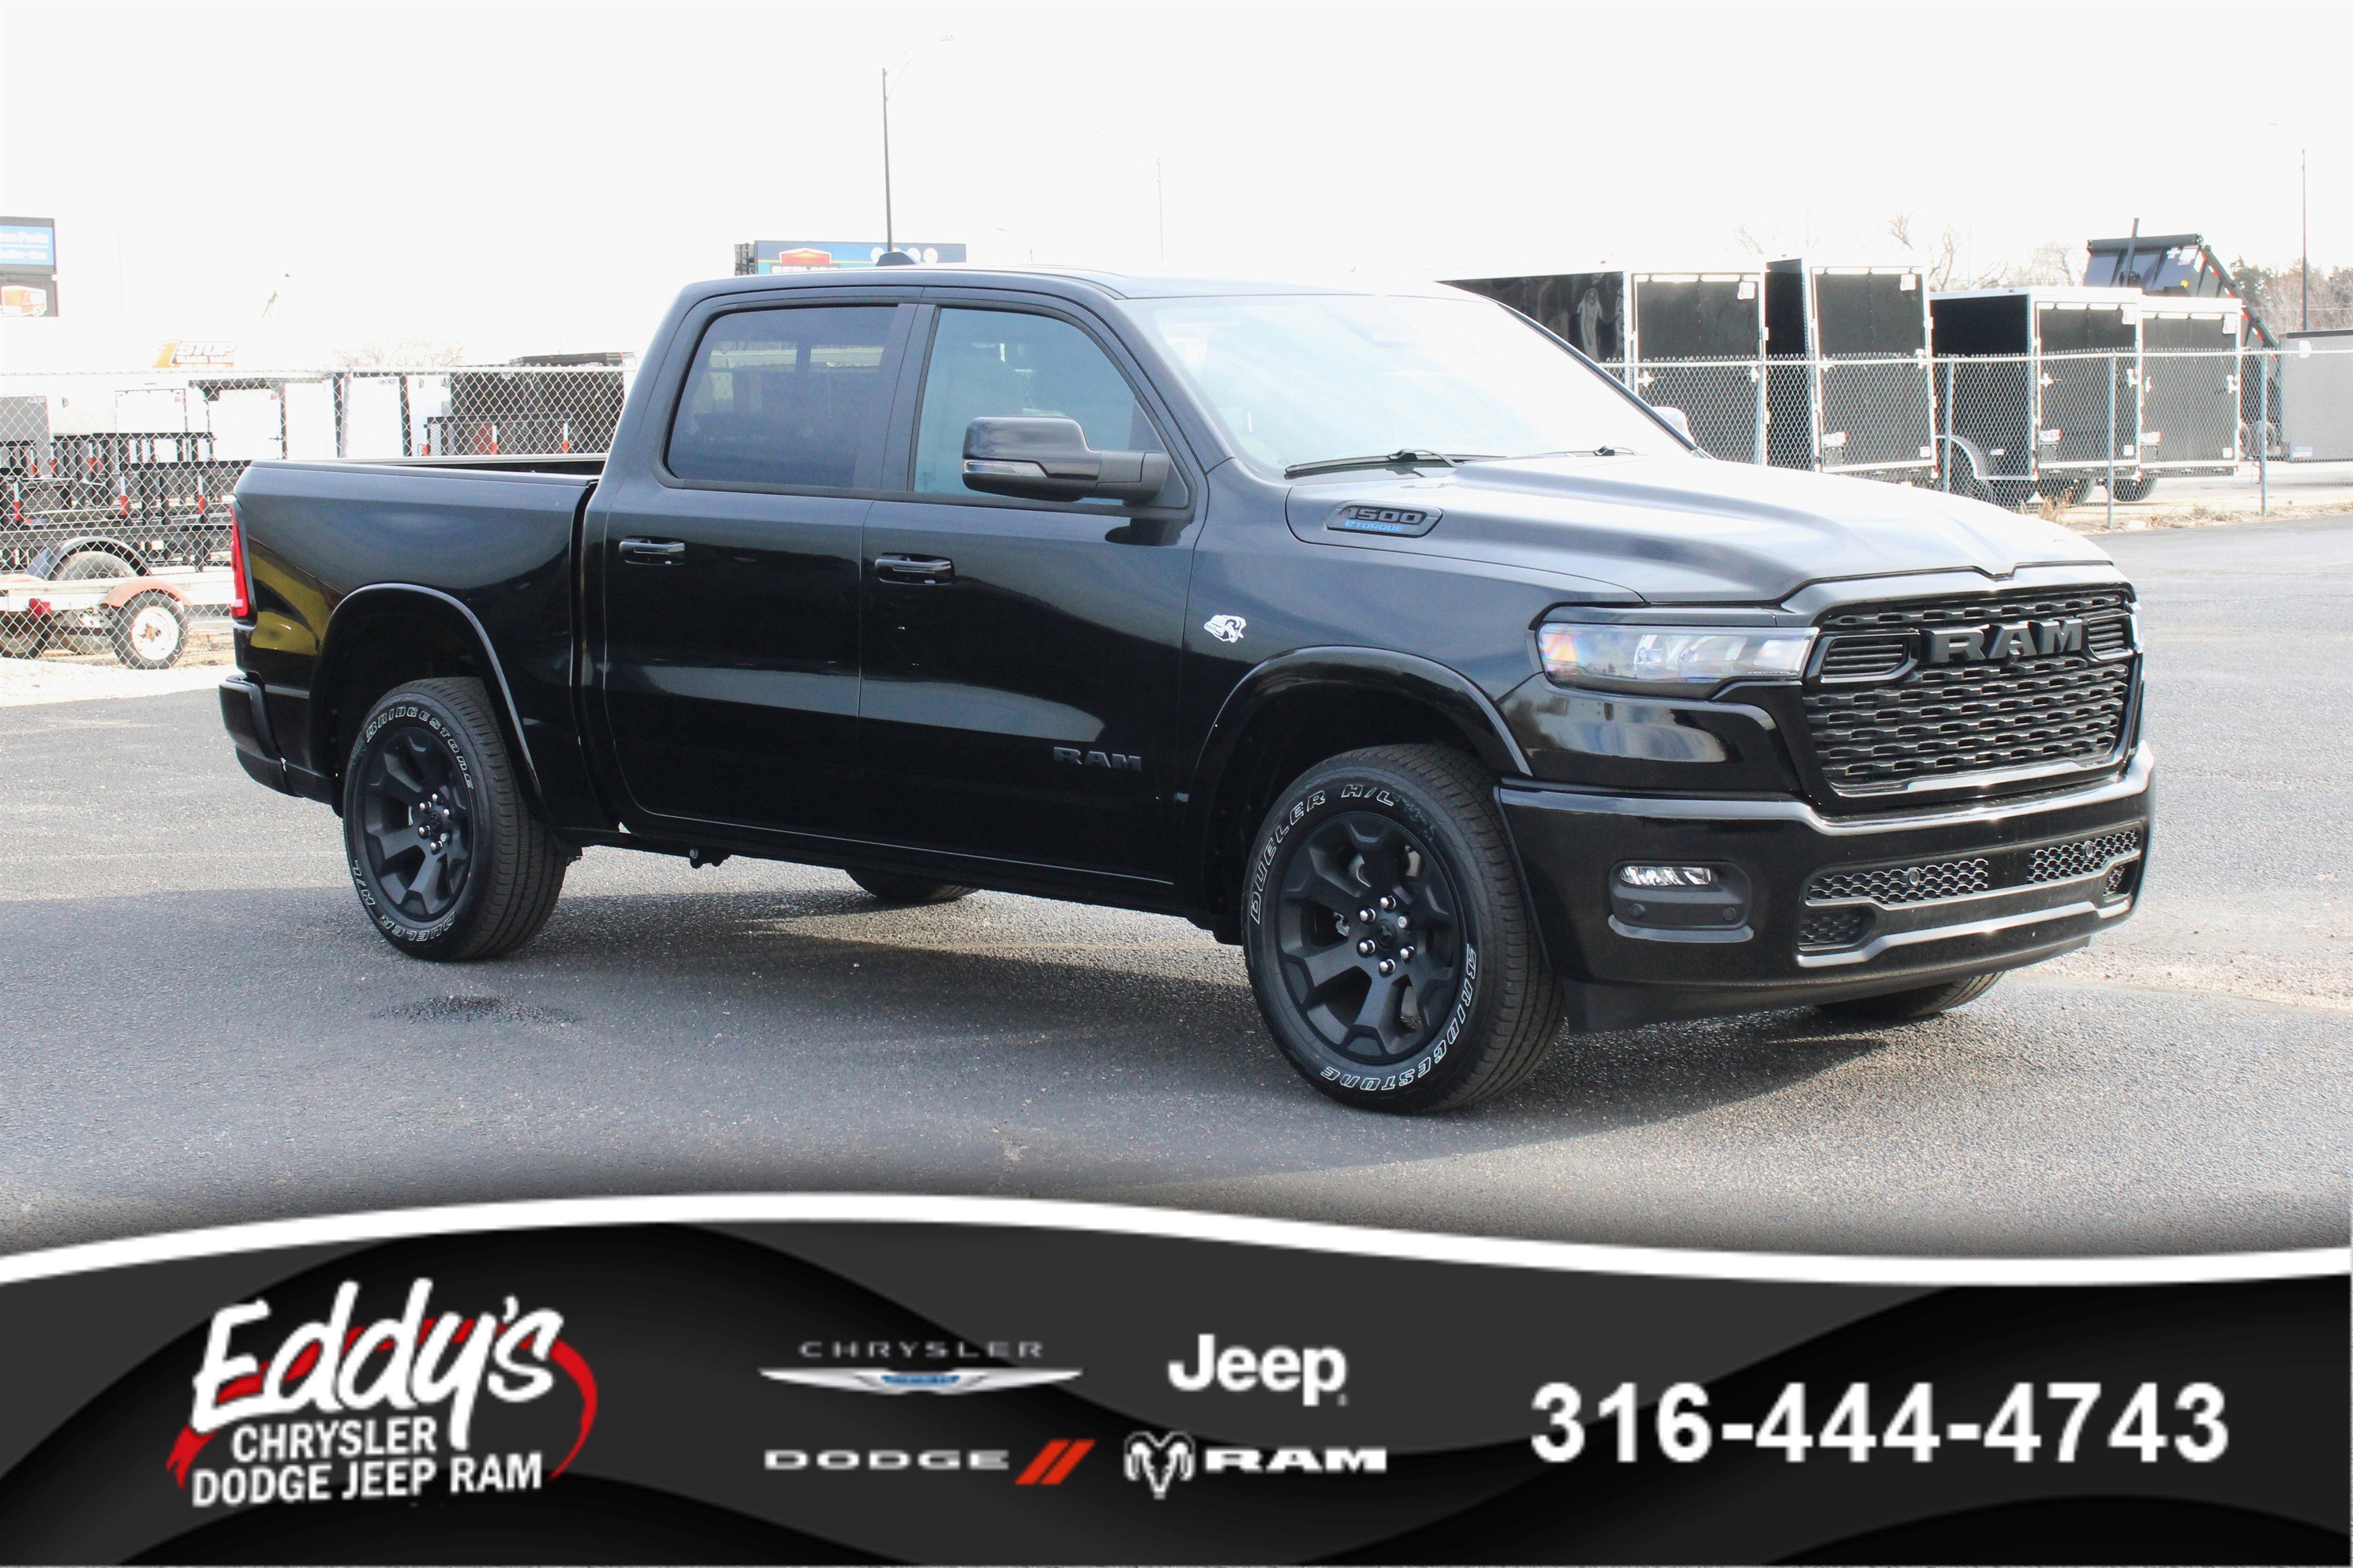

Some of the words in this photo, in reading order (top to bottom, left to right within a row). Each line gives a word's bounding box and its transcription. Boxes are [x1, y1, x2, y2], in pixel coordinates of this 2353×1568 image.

[175, 341, 237, 356] STOP
[1348, 508, 1426, 524] 1500
[1927, 617, 2084, 661] RAM
[365, 706, 474, 790] BRIDGESTONE
[1054, 747, 1141, 771] RAM
[1250, 789, 1326, 925] DUELER
[1341, 783, 1395, 807] H/L
[1320, 943, 1477, 1092] BRIDGESTONE
